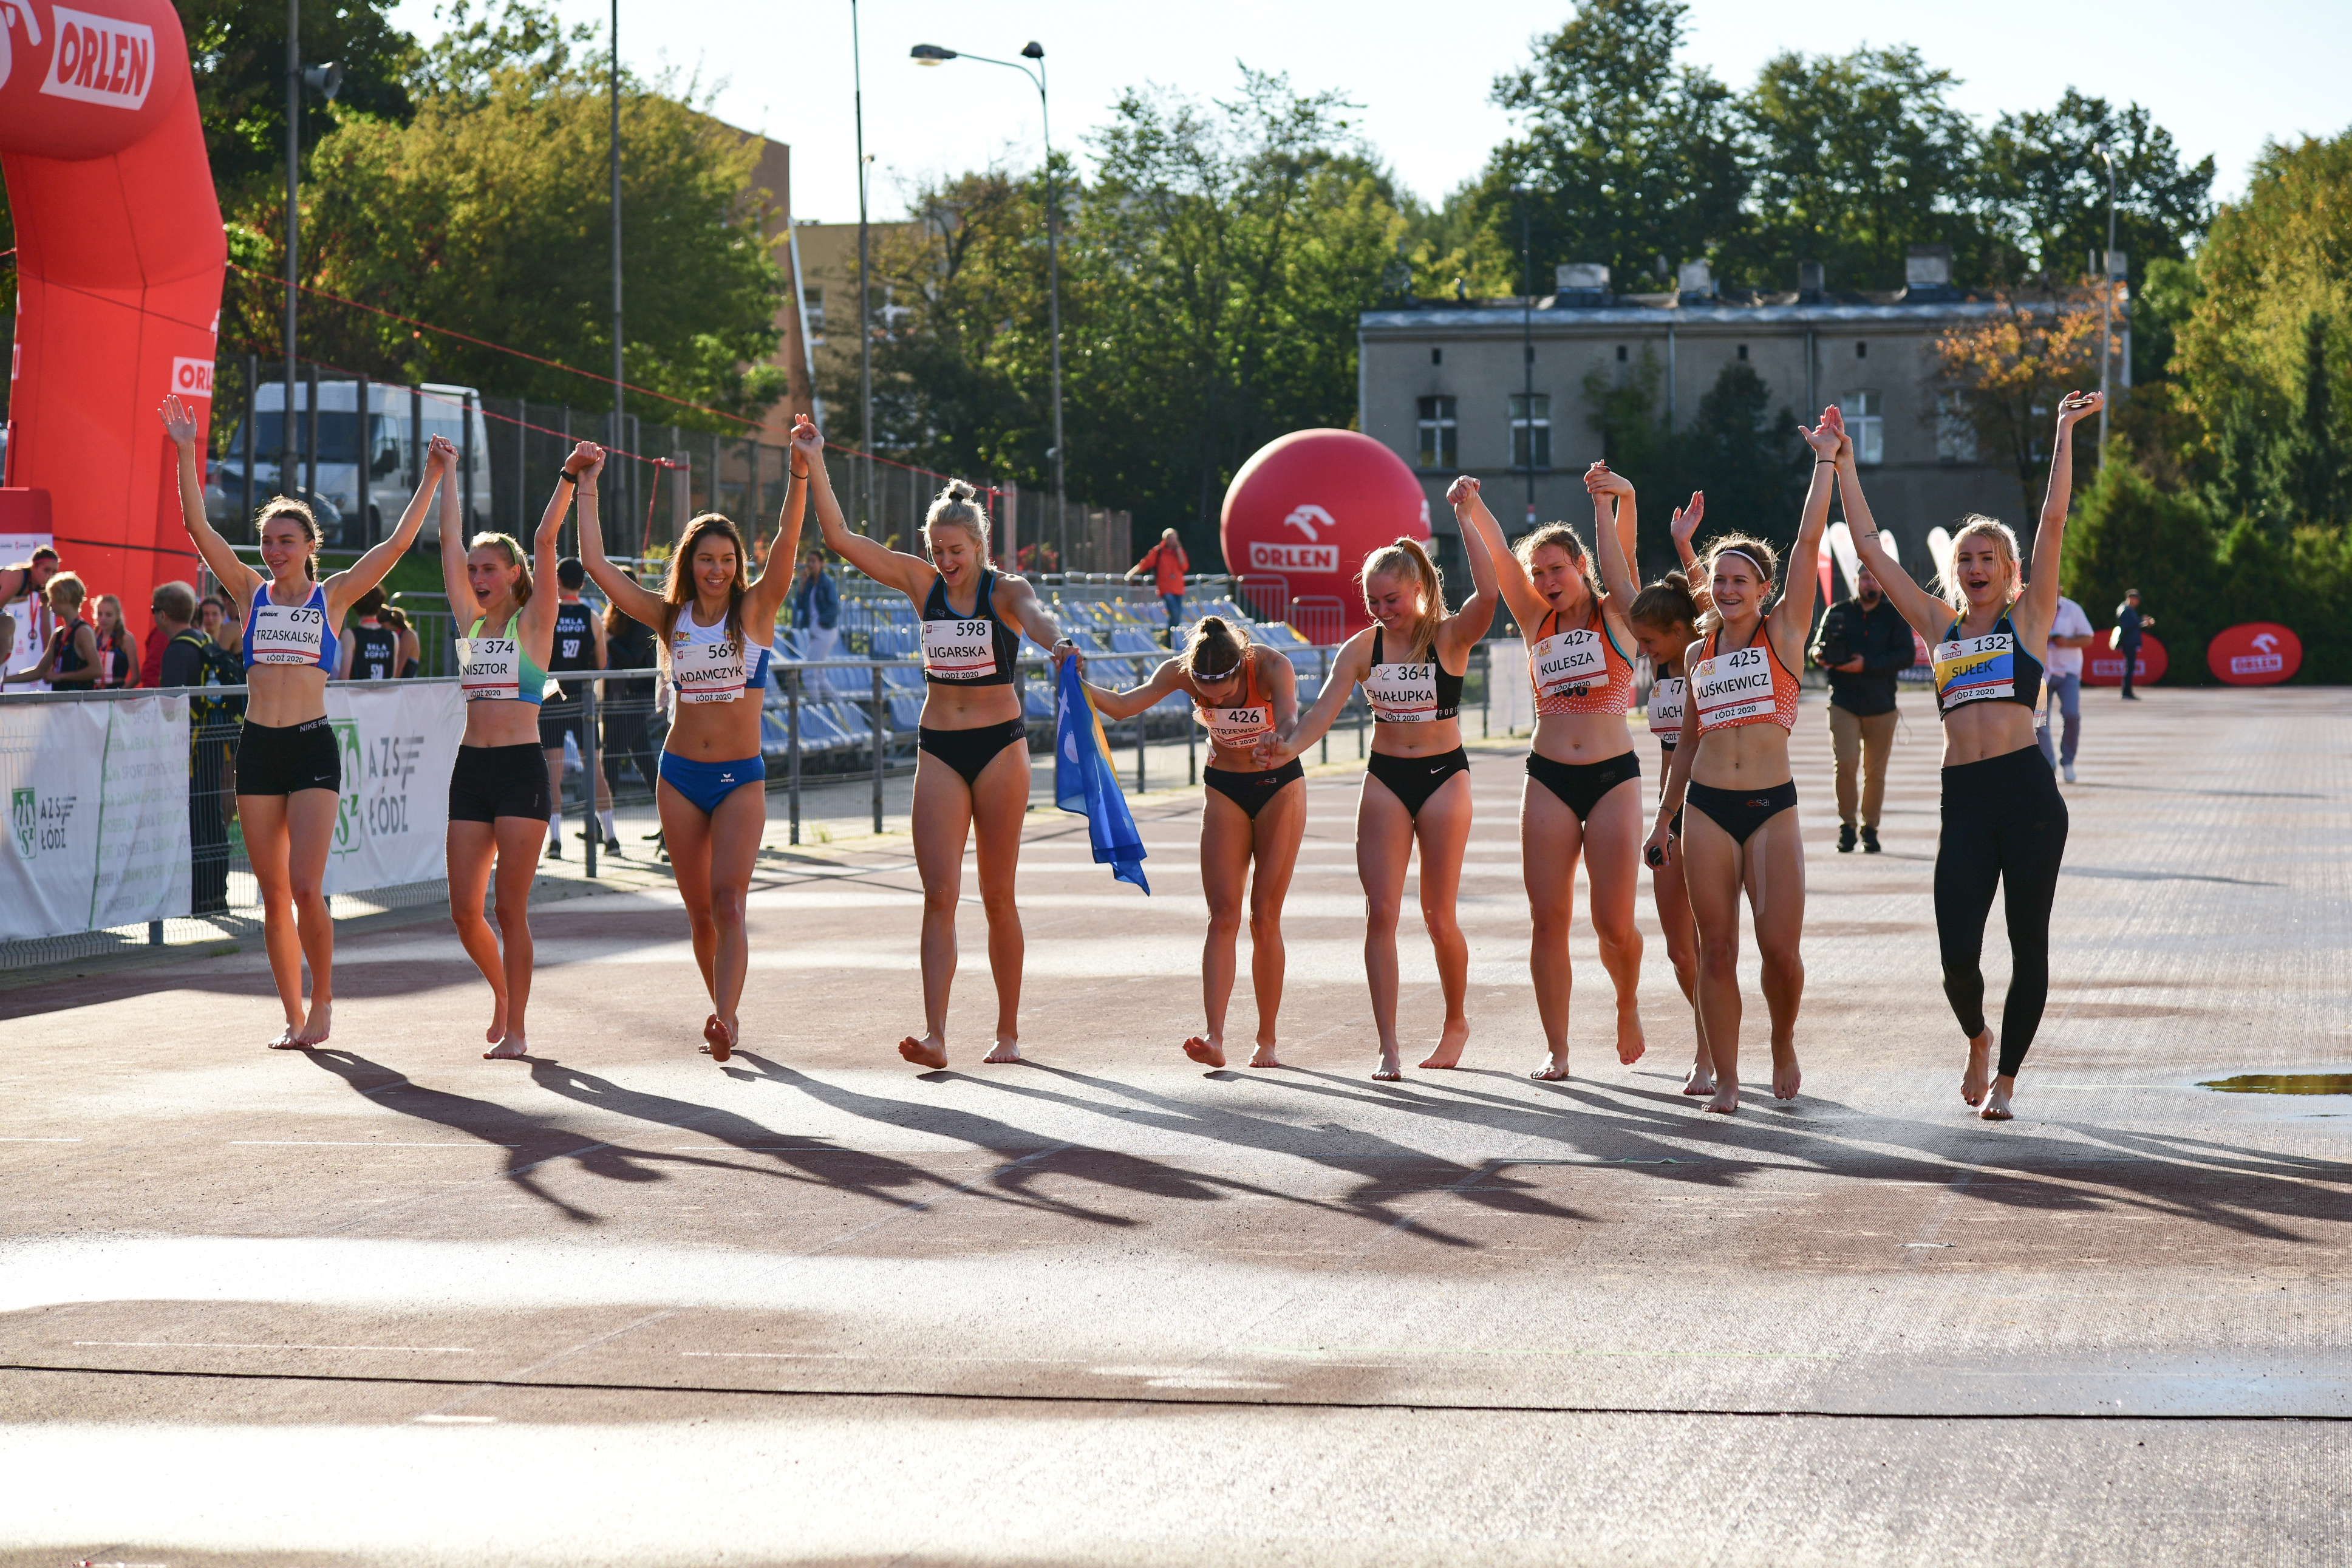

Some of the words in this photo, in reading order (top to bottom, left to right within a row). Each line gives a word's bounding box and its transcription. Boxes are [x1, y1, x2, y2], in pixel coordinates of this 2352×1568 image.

[57, 21, 148, 97] ORLEN
[1255, 548, 1330, 567] ORLEN
[290, 609, 319, 624] 673
[556, 624, 586, 633] SOPOT
[956, 622, 986, 636] 598
[256, 629, 319, 646] TRZASKALSKA
[1974, 636, 2006, 653] 132
[485, 641, 514, 653] 374
[562, 639, 580, 658] 527
[708, 643, 737, 659] 569
[928, 646, 987, 658] LIGARSKA
[1541, 652, 1595, 676] KULESZA
[1729, 650, 1761, 668] 425
[463, 663, 508, 676] NISZTOR
[680, 666, 743, 683] ADAMCZYK
[1398, 666, 1430, 681] 364
[1952, 660, 1994, 678] SUŁEK
[470, 688, 484, 697] ŁÓDŹ
[1554, 683, 1572, 692] ŁÓDŹ
[1671, 679, 1687, 695] 47
[1697, 673, 1769, 700] JUŚKIEWICZ
[695, 693, 713, 701] ŁÓDŹ
[1366, 690, 1434, 702] CHAŁUPKA
[1955, 689, 1973, 701] ŁÓDŹ
[1229, 710, 1260, 723] 426
[1385, 712, 1400, 721] ŁÓDŹ
[1657, 705, 1683, 718] LACH
[1715, 707, 1736, 720] ŁÓDŹ
[1737, 705, 1756, 715] 2020
[299, 721, 317, 732] NIKE
[318, 718, 327, 727] PRO
[369, 737, 400, 779] AZS
[40, 796, 60, 819] AZS
